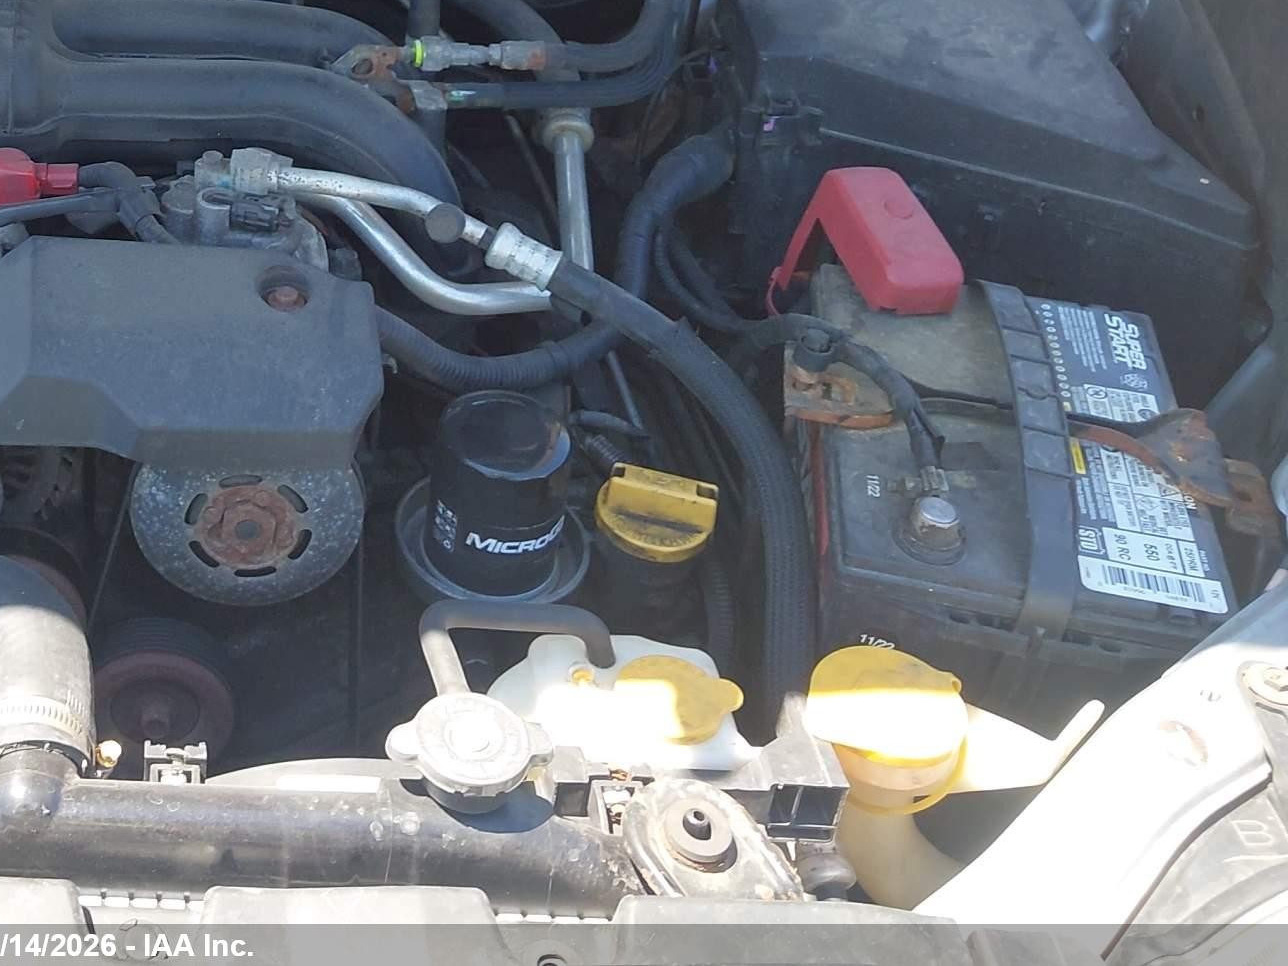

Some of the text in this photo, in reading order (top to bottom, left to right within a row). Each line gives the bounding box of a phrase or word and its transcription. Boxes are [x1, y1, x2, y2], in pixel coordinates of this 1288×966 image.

[1104, 313, 1134, 369] START
[1123, 322, 1147, 370] SUPER
[866, 474, 881, 499] 11/22
[1114, 533, 1127, 545] 90
[1116, 547, 1131, 561] RC
[1144, 543, 1160, 562] 550
